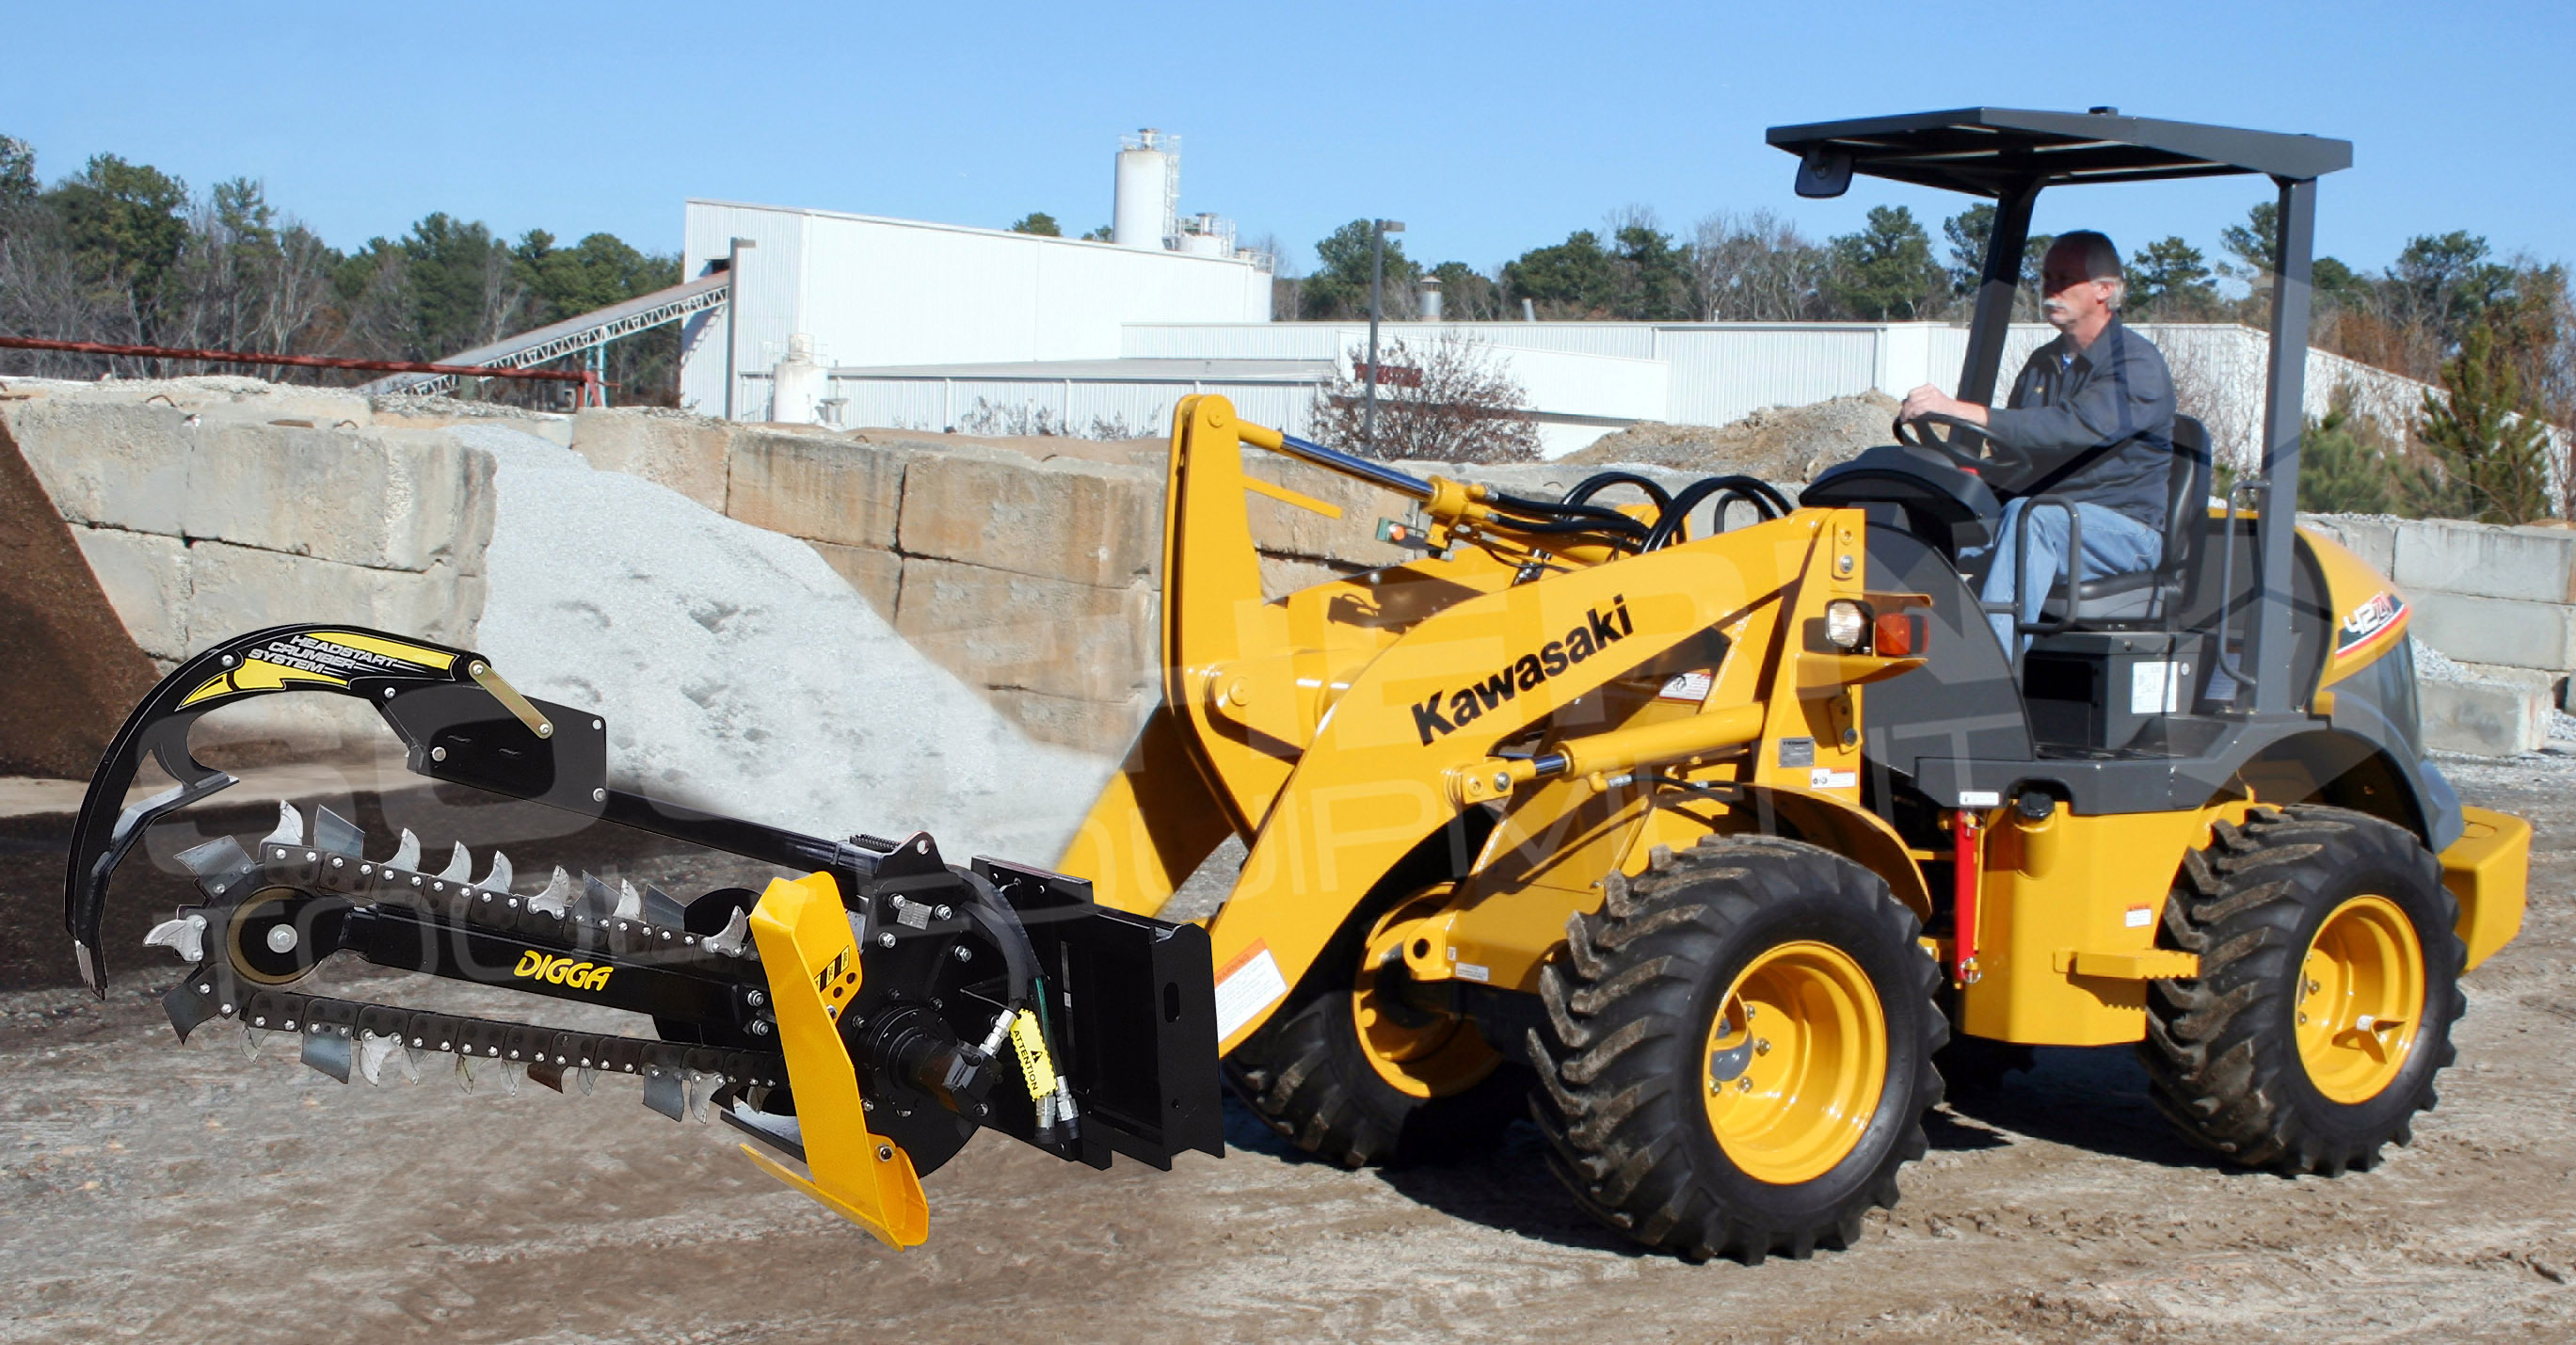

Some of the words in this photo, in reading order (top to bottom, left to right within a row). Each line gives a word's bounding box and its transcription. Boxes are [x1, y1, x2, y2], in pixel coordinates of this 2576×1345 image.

[248, 648, 325, 674] SYSTEM
[267, 641, 356, 669] CRUMBER
[290, 634, 399, 667] HEADSTART
[1411, 593, 1634, 747] Kawasaki
[514, 950, 615, 992] DIGGA
[1014, 1030, 1038, 1091] ATTENTION
